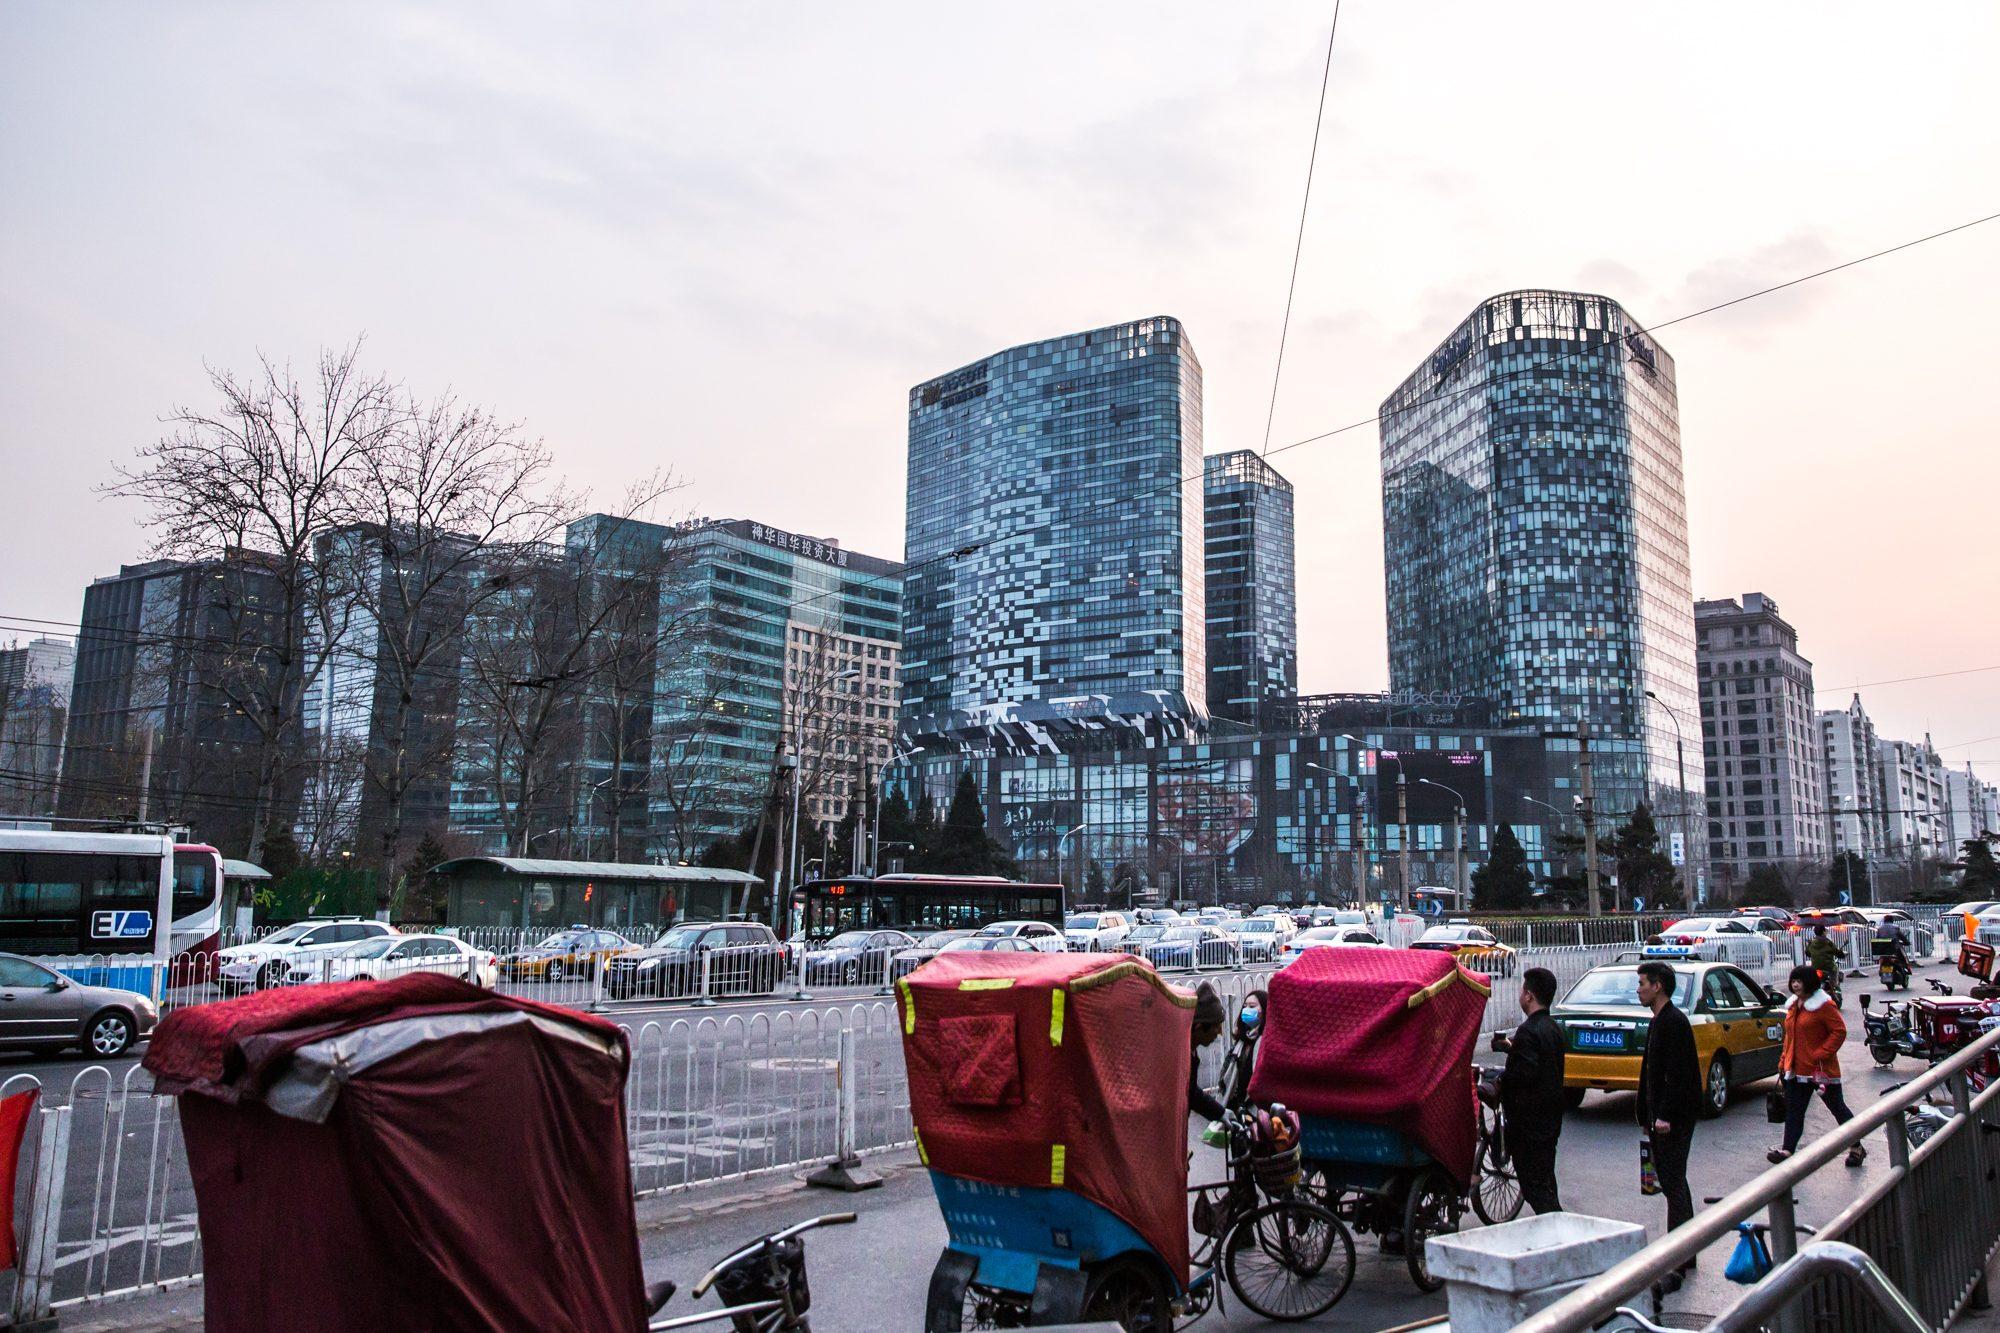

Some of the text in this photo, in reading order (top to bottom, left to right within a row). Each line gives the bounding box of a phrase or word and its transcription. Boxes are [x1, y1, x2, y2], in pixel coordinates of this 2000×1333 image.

[752, 523, 848, 567] 神华国华投资大厦
[1381, 688, 1429, 705] Raffles
[93, 911, 130, 936] EV
